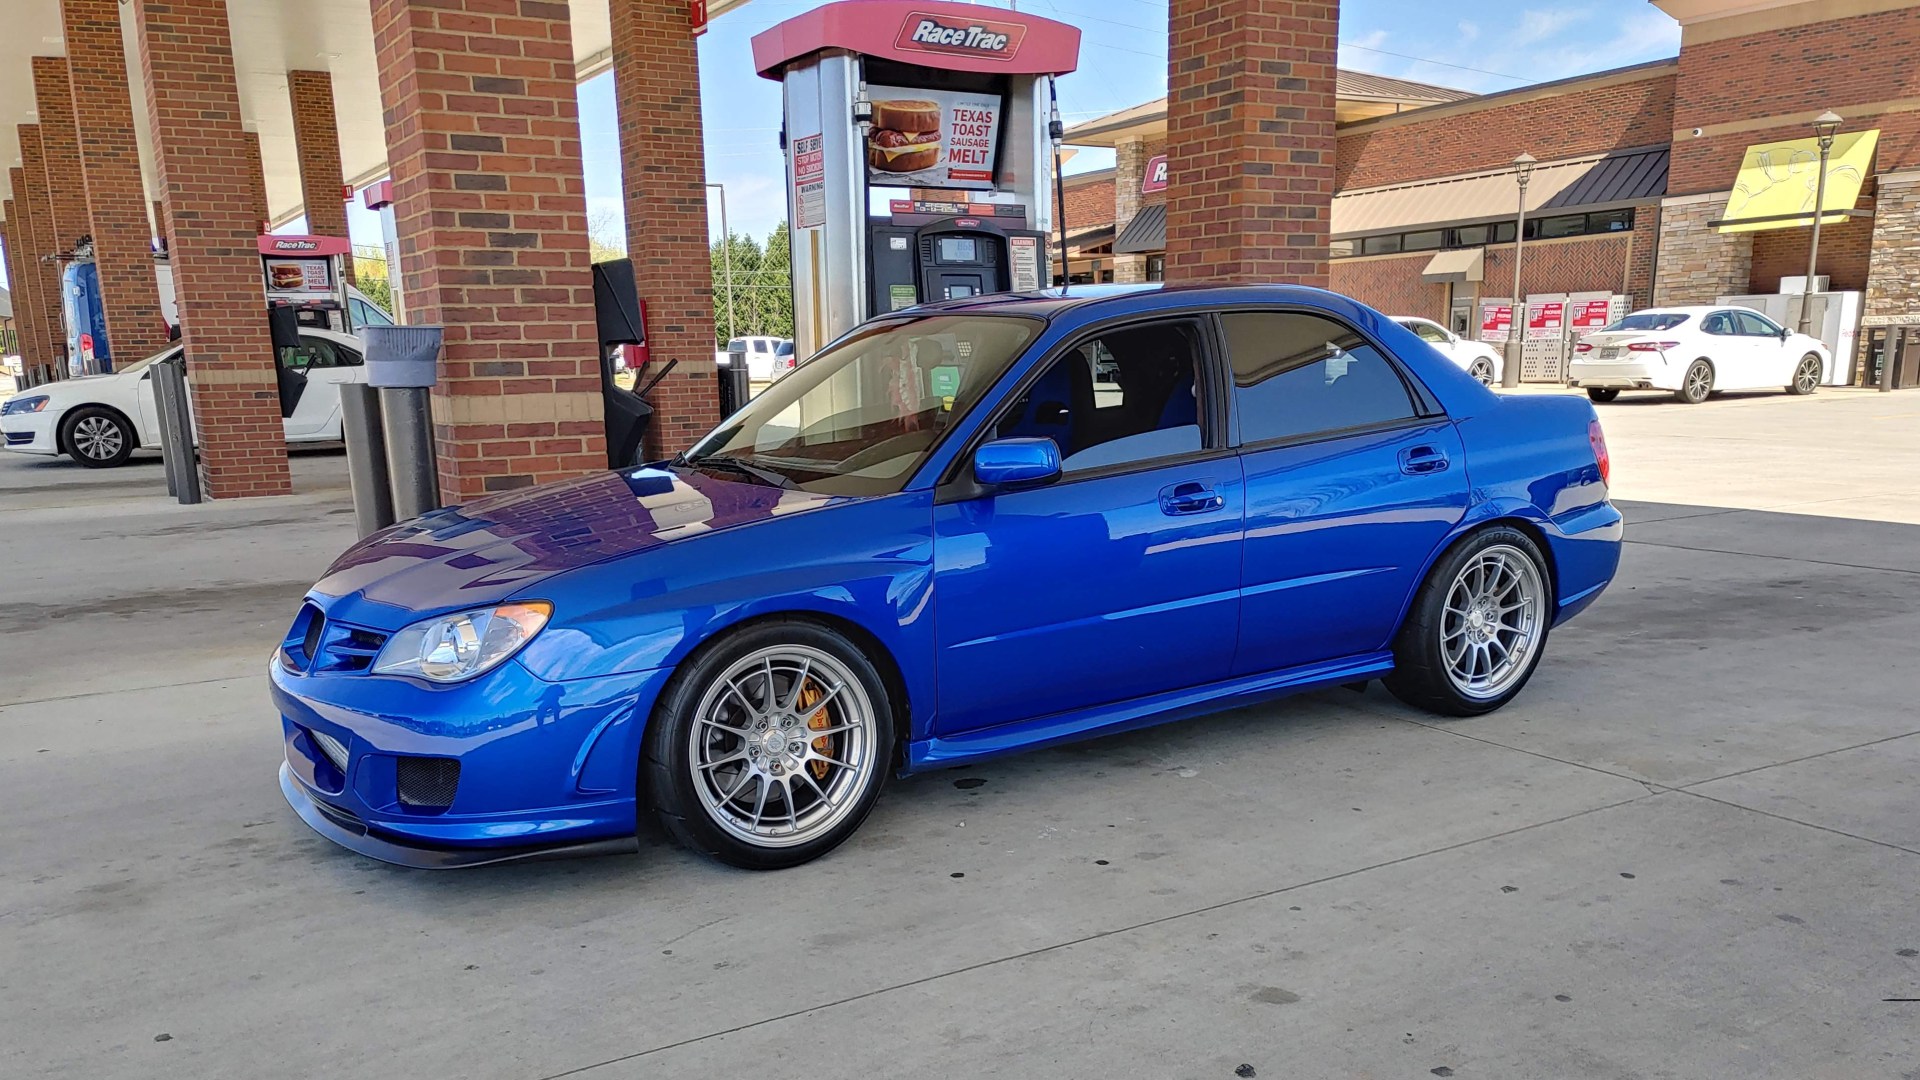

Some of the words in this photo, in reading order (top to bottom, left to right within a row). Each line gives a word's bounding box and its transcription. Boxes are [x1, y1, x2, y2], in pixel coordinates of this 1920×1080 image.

[912, 21, 1007, 50] RaceTrac
[953, 108, 993, 123] TEXAS
[951, 123, 991, 137] TOAST
[797, 141, 808, 154] SELF
[950, 137, 989, 148] SAUSAGE
[949, 148, 989, 165] MELT
[798, 165, 806, 175] NO
[1153, 162, 1167, 181] R
[801, 181, 824, 193] WARNING
[275, 241, 316, 249] RaceTrac
